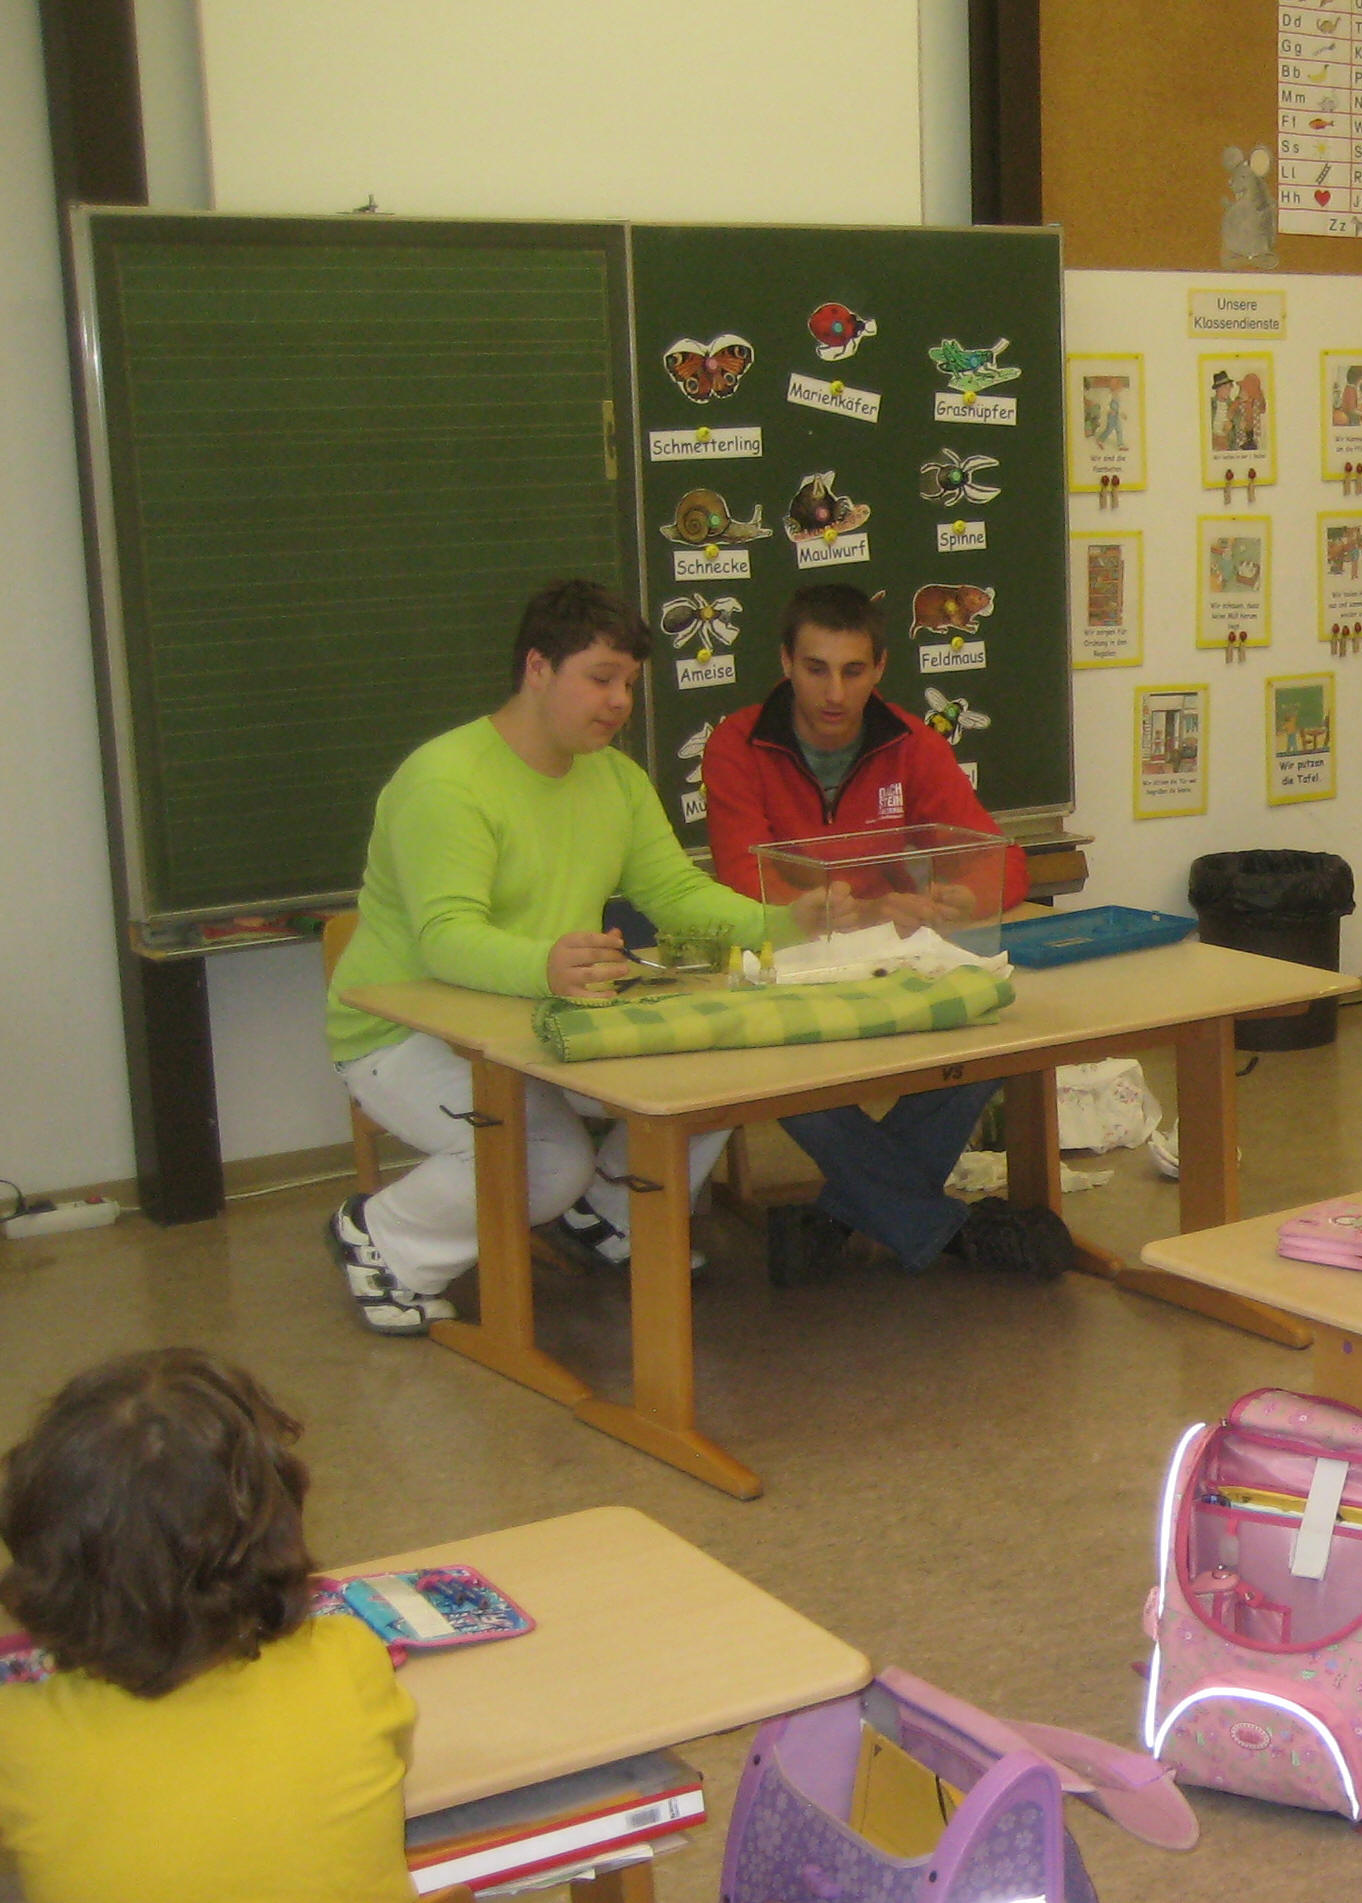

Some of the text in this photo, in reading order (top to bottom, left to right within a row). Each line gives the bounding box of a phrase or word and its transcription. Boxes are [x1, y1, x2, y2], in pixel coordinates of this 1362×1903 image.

[1217, 297, 1257, 311] Unsere
[1193, 316, 1280, 330] Klassendienste
[789, 382, 878, 416] Marienkäfer
[936, 400, 1015, 424] Grashüpfer
[652, 435, 760, 456] Schmetterling
[939, 532, 985, 551] Spinne
[800, 540, 866, 563] Maulwurf
[676, 558, 749, 576] Schnecke
[921, 650, 985, 669] Feldmaus
[680, 663, 734, 683] Ameise
[1279, 760, 1295, 771] Wir
